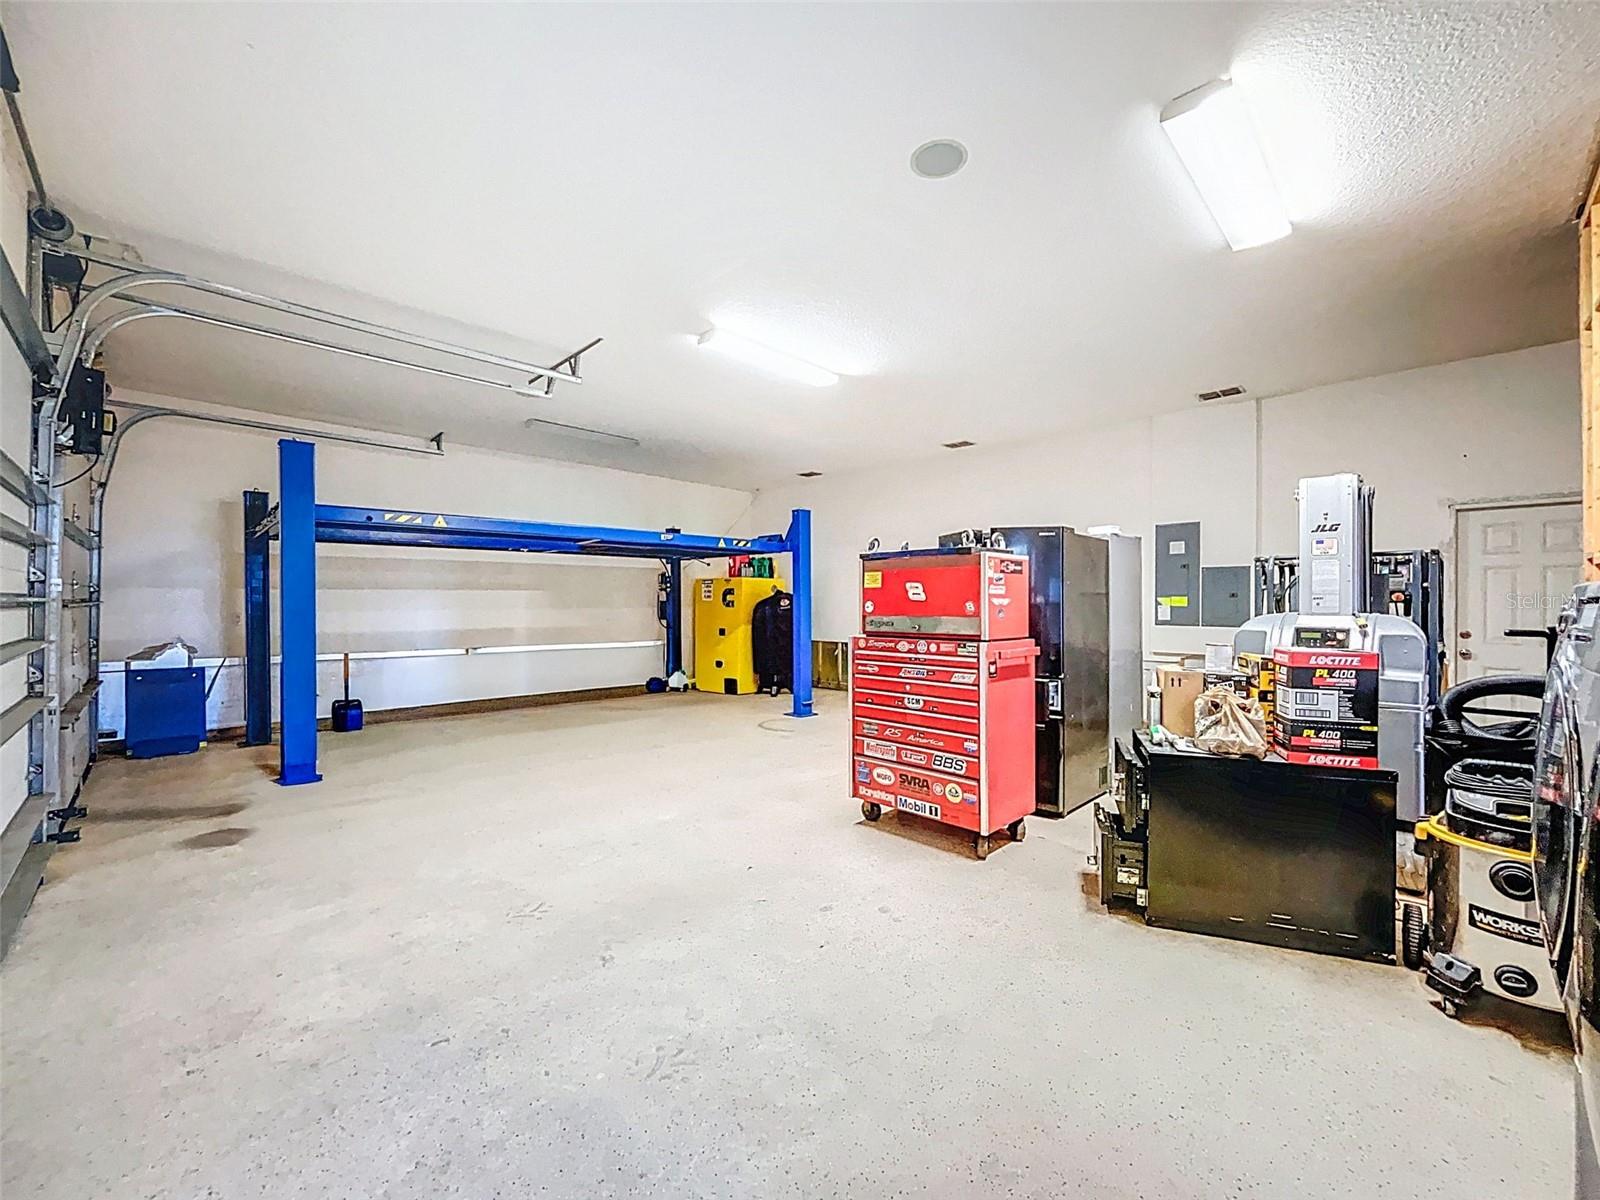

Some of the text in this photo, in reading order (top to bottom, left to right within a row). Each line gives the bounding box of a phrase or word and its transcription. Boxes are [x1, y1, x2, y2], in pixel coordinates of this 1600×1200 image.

[1311, 523, 1341, 533] JLG
[1309, 656, 1361, 666] LOCTITE
[1315, 669, 1356, 678] PL 400
[906, 697, 921, 705] SCM
[883, 728, 903, 737] RS
[906, 734, 945, 746] America
[1303, 729, 1341, 739] PL 400
[932, 754, 965, 771] BBS
[1308, 755, 1361, 766] LOCTITE
[899, 773, 930, 790] SVRA
[898, 797, 939, 817] Mobil 1
[1472, 909, 1542, 938] WORKS
